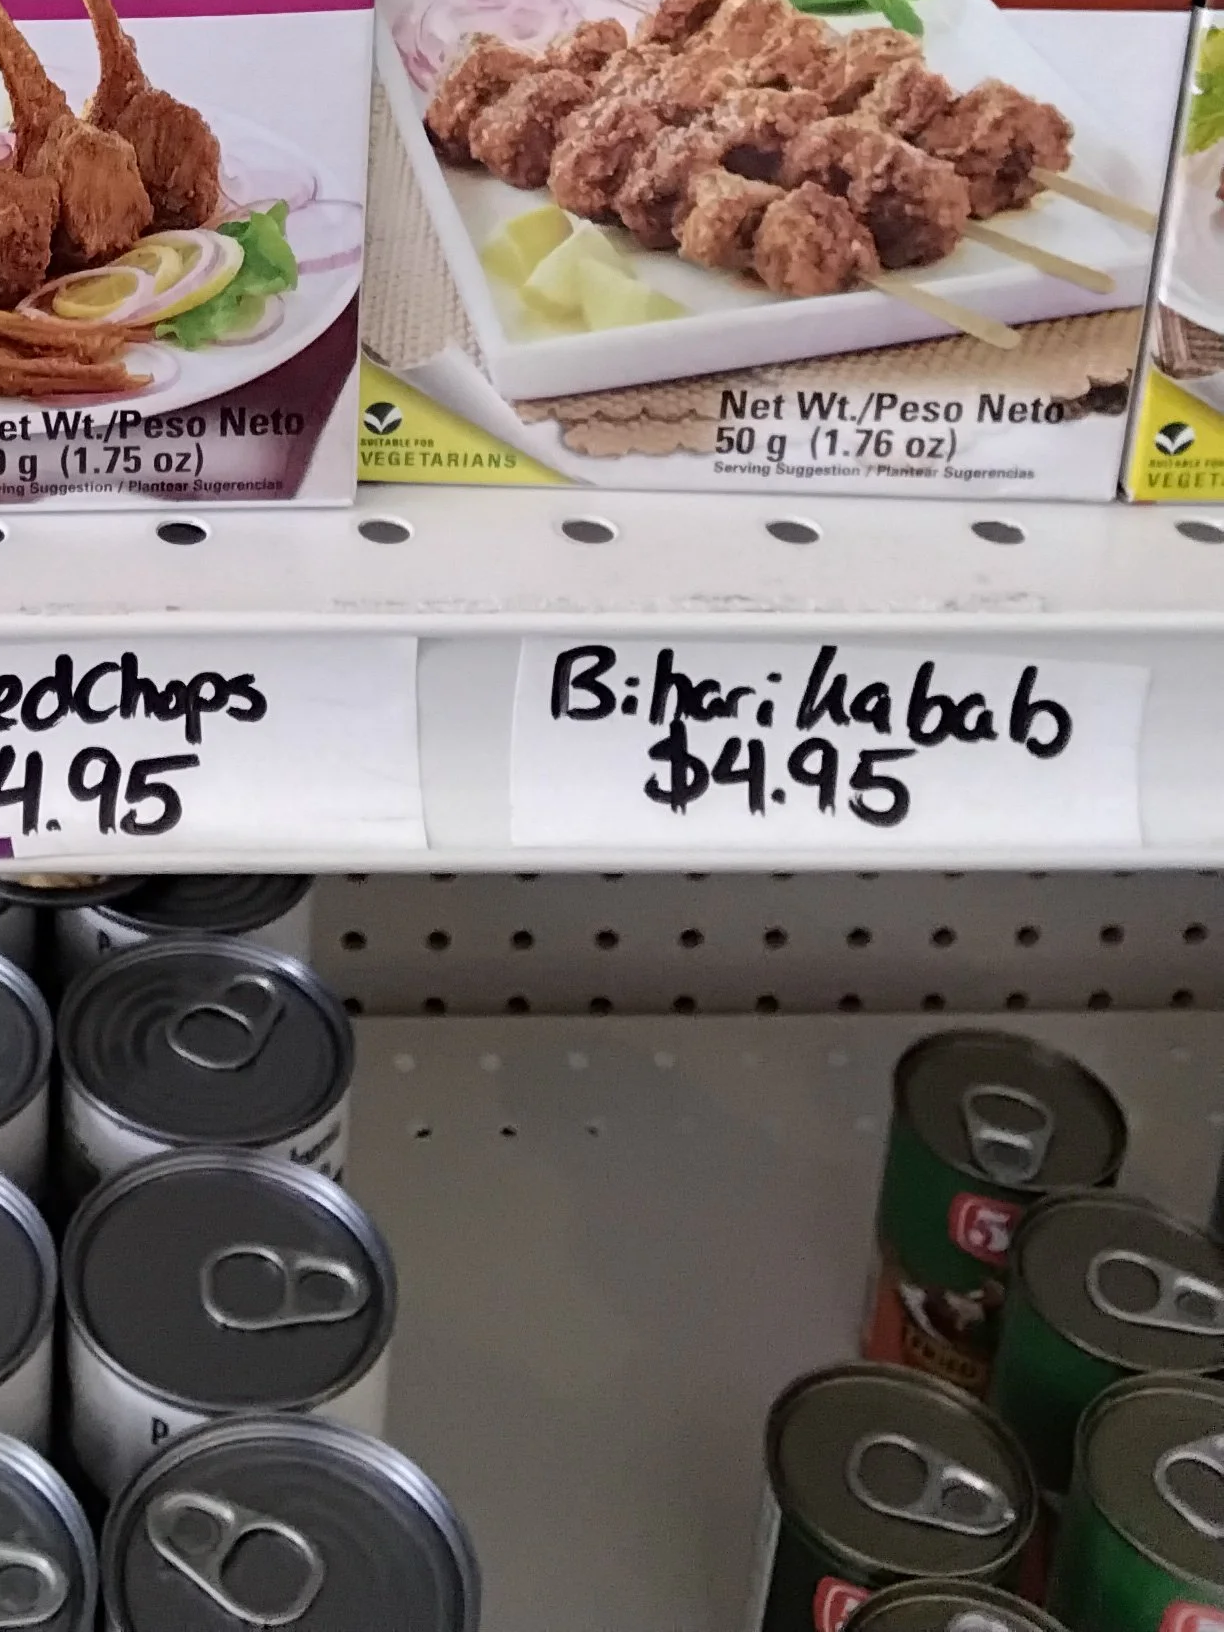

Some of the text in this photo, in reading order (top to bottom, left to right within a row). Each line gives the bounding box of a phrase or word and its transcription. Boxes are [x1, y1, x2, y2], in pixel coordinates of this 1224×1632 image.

[717, 387, 1068, 424] Net Wt./Peso Neto
[42, 408, 211, 443] Wt./Peso
[216, 407, 303, 441] Neto
[360, 438, 434, 447] SUITABLE FOR
[358, 448, 520, 468] VEGETARIANS
[715, 426, 956, 464] 50 g (1.76 oz)
[19, 455, 38, 484] g
[61, 445, 141, 479] (1.75
[154, 443, 204, 477] oz)
[714, 459, 1034, 482] Serving Suggestion / Plantear Sugerencias
[27, 478, 116, 499] Suggestion
[117, 480, 124, 495] /
[129, 480, 192, 497] Plantear
[190, 475, 287, 496] Sugerencias
[644, 719, 919, 827] $4.95
